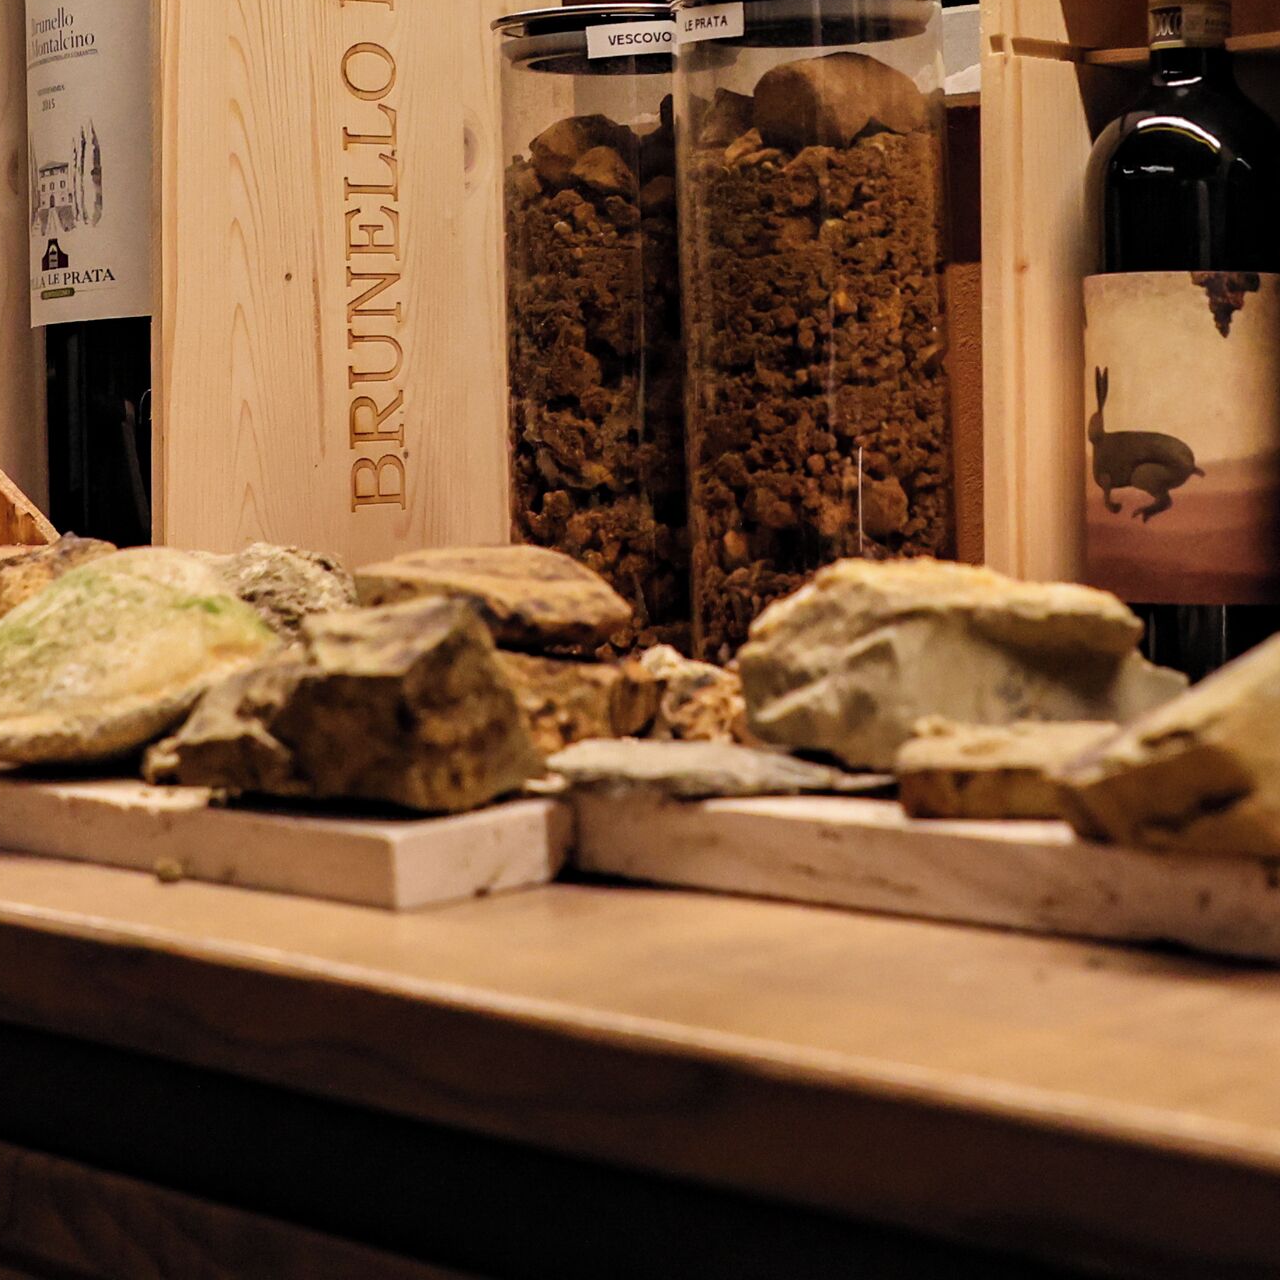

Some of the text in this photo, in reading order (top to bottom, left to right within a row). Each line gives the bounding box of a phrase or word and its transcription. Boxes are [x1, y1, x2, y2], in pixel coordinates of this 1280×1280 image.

[685, 15, 728, 32] LE PRATA
[608, 31, 672, 46] VESCOVO
[48, 272, 60, 286] LE
[63, 268, 116, 286] PRATA
[340, 41, 406, 513] BRUNELLO
